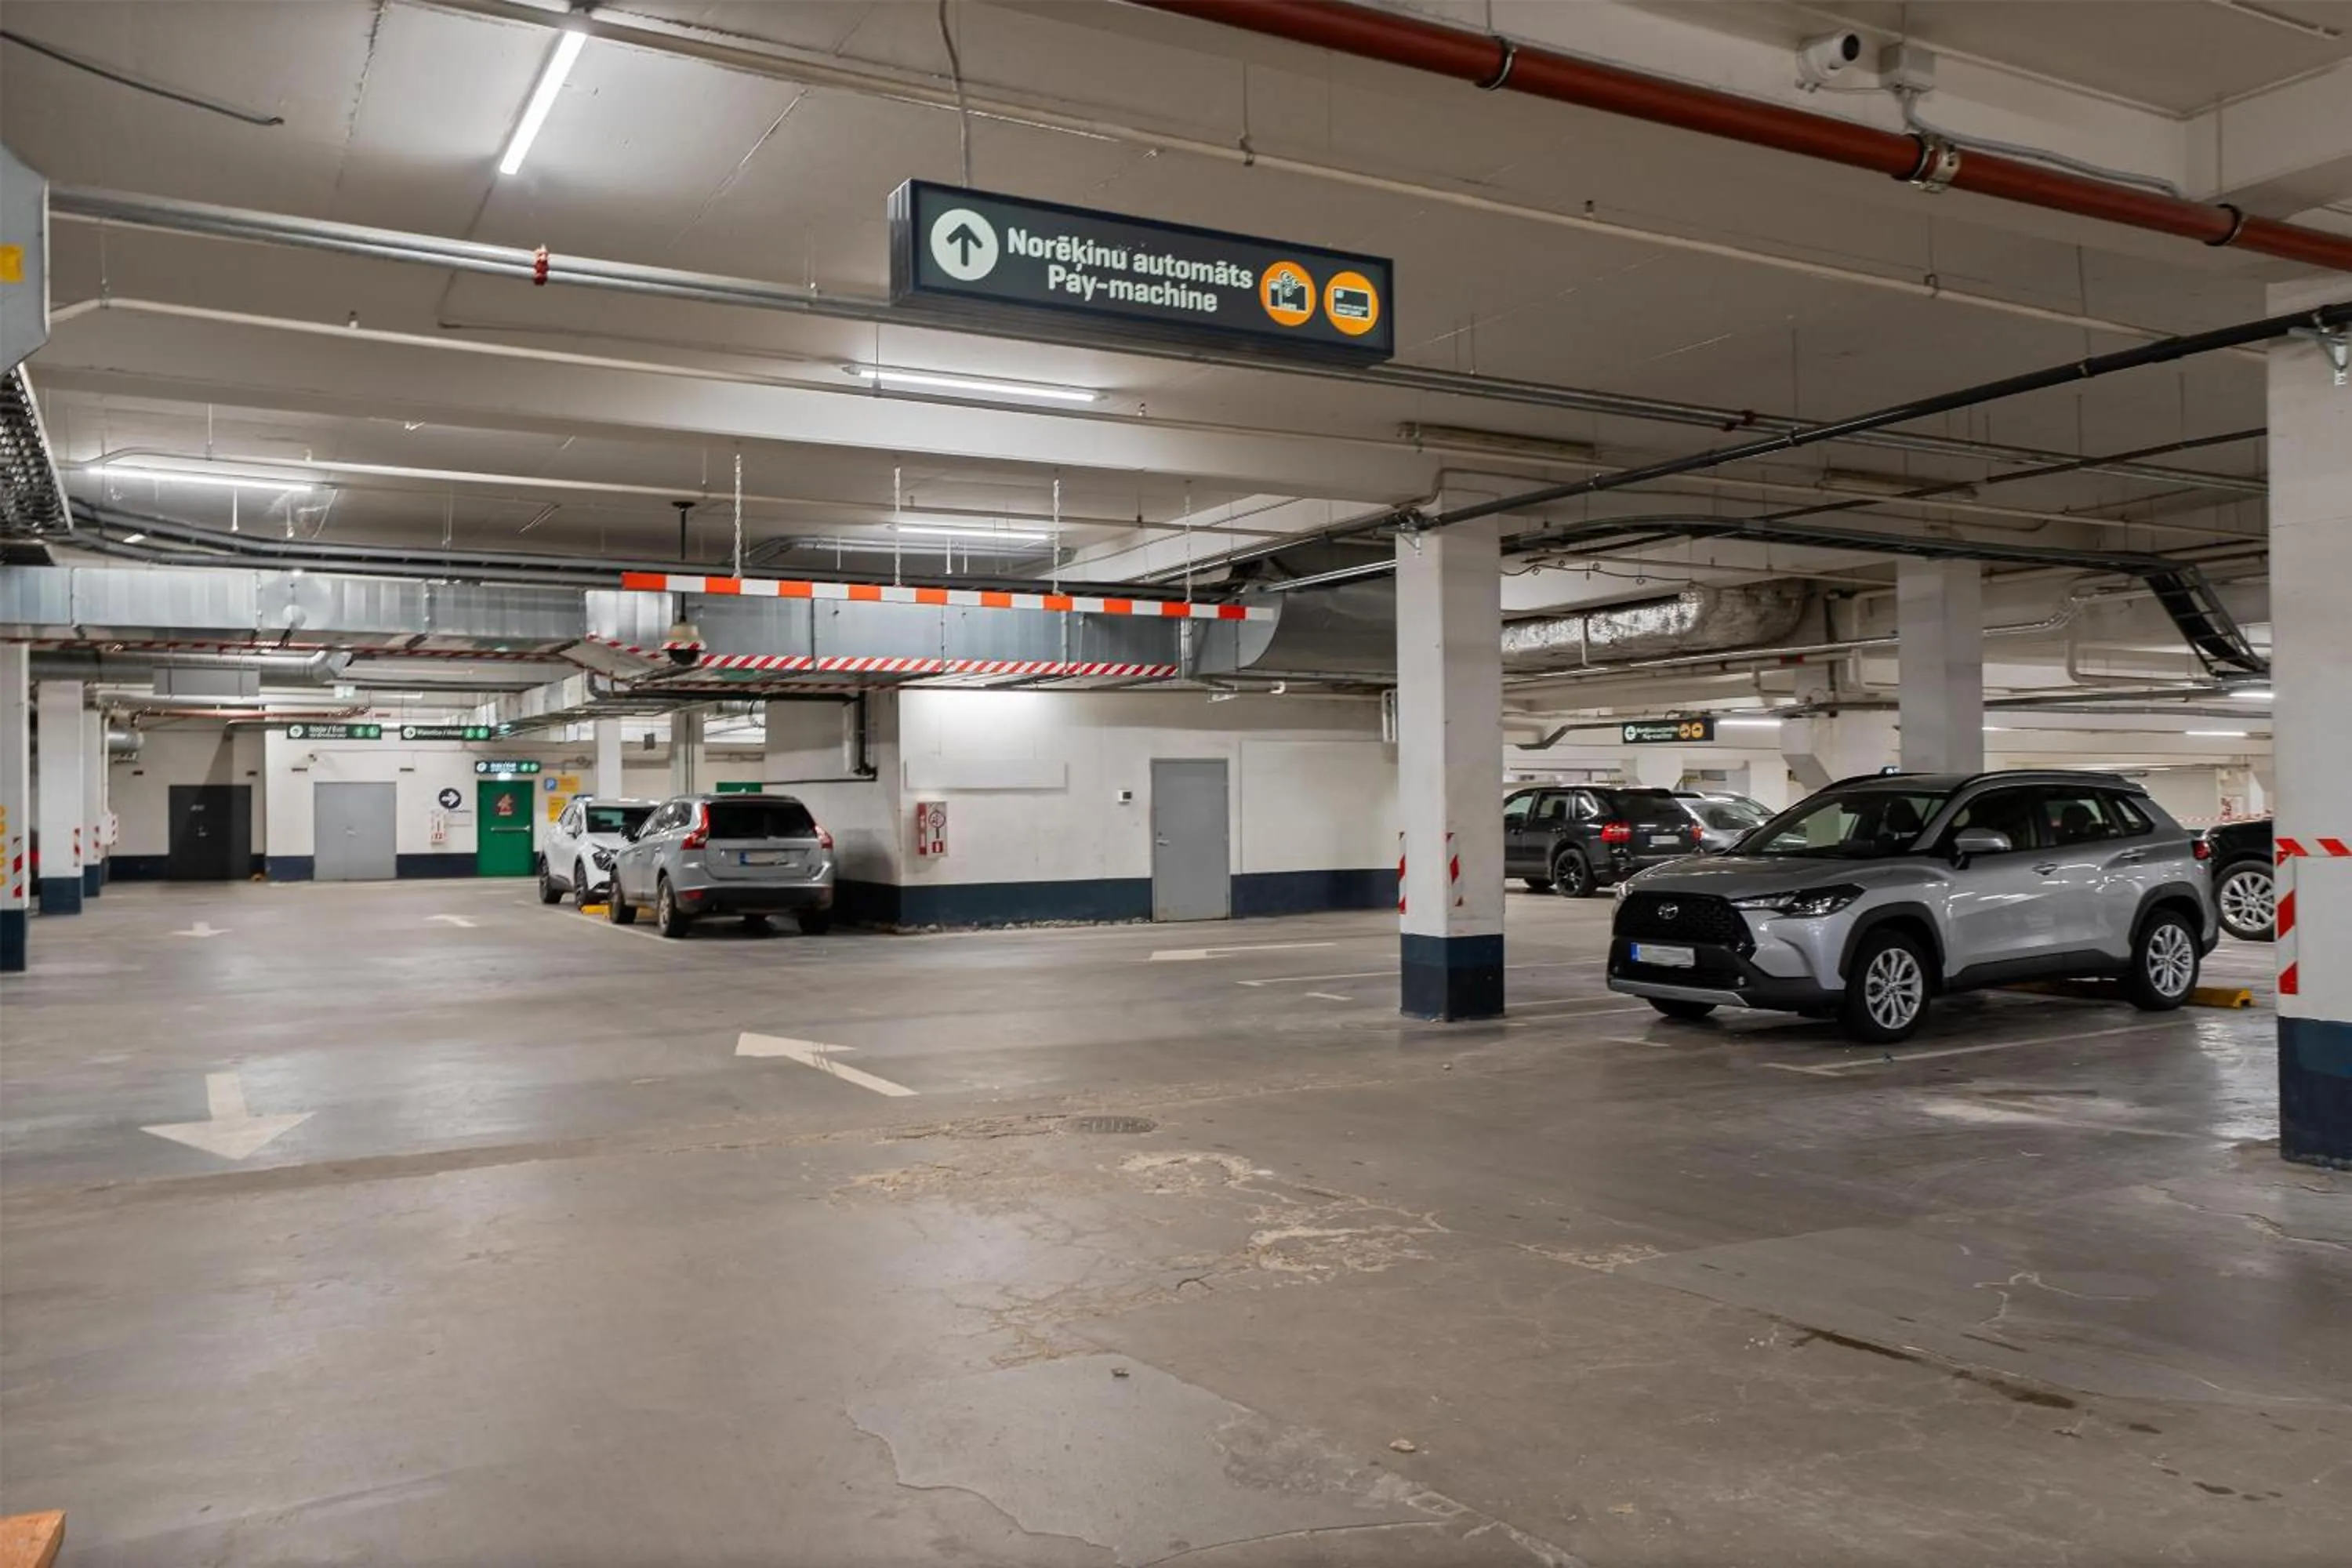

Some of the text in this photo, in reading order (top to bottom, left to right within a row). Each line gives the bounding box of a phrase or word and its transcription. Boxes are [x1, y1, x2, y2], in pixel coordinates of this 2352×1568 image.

[1007, 227, 1254, 289] Norēķinu automāts
[1047, 264, 1218, 313] Pay-machine
